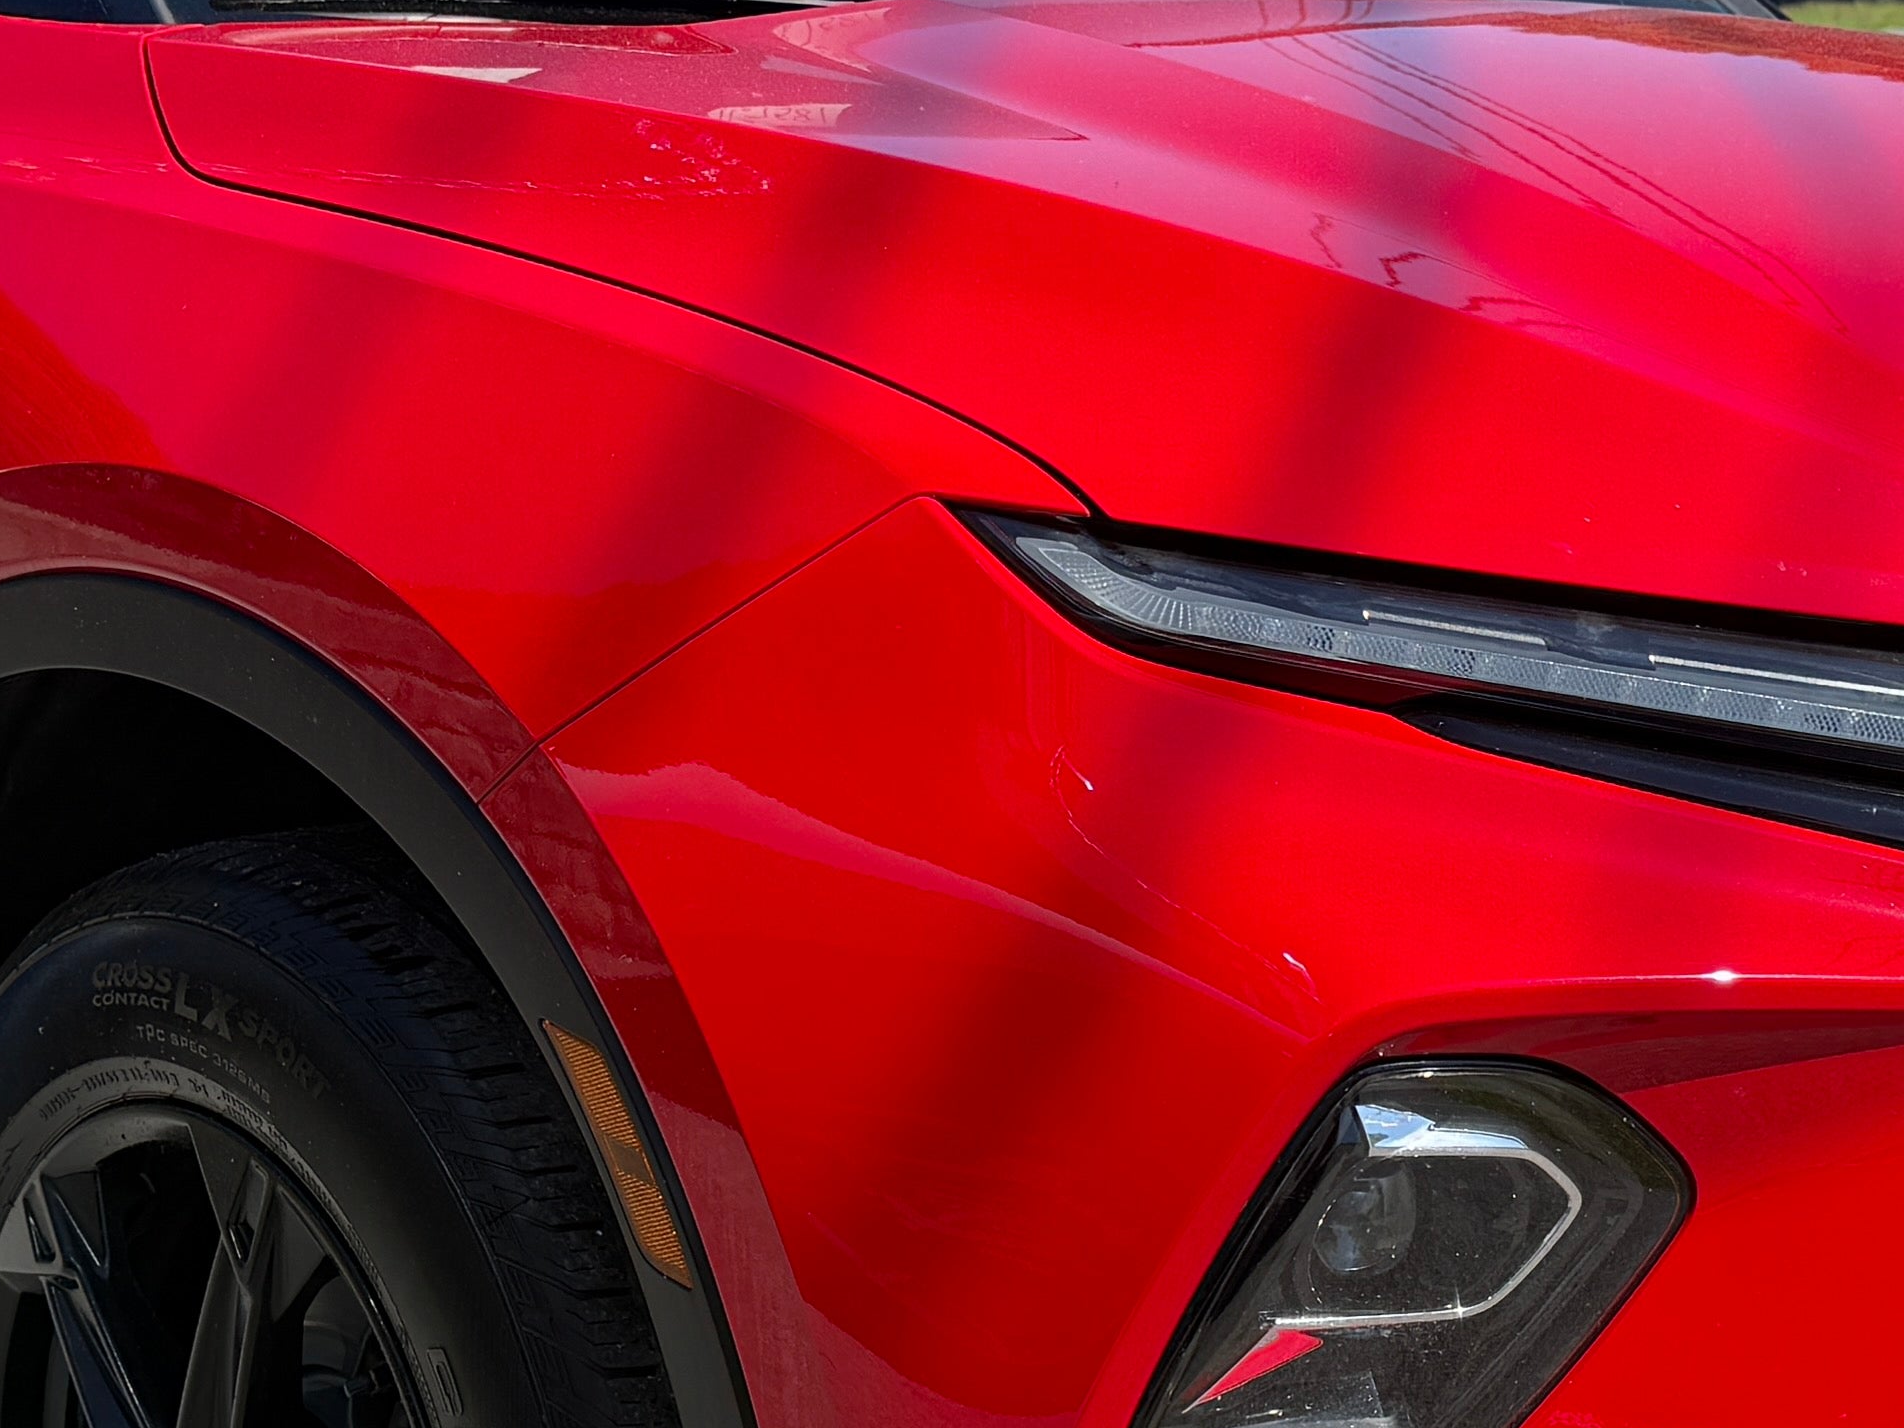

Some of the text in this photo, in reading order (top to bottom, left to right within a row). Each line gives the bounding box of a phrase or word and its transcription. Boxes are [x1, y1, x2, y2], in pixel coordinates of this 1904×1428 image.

[91, 959, 173, 993] CROSS
[91, 990, 172, 1012] CONTACT
[173, 971, 239, 1043] LX
